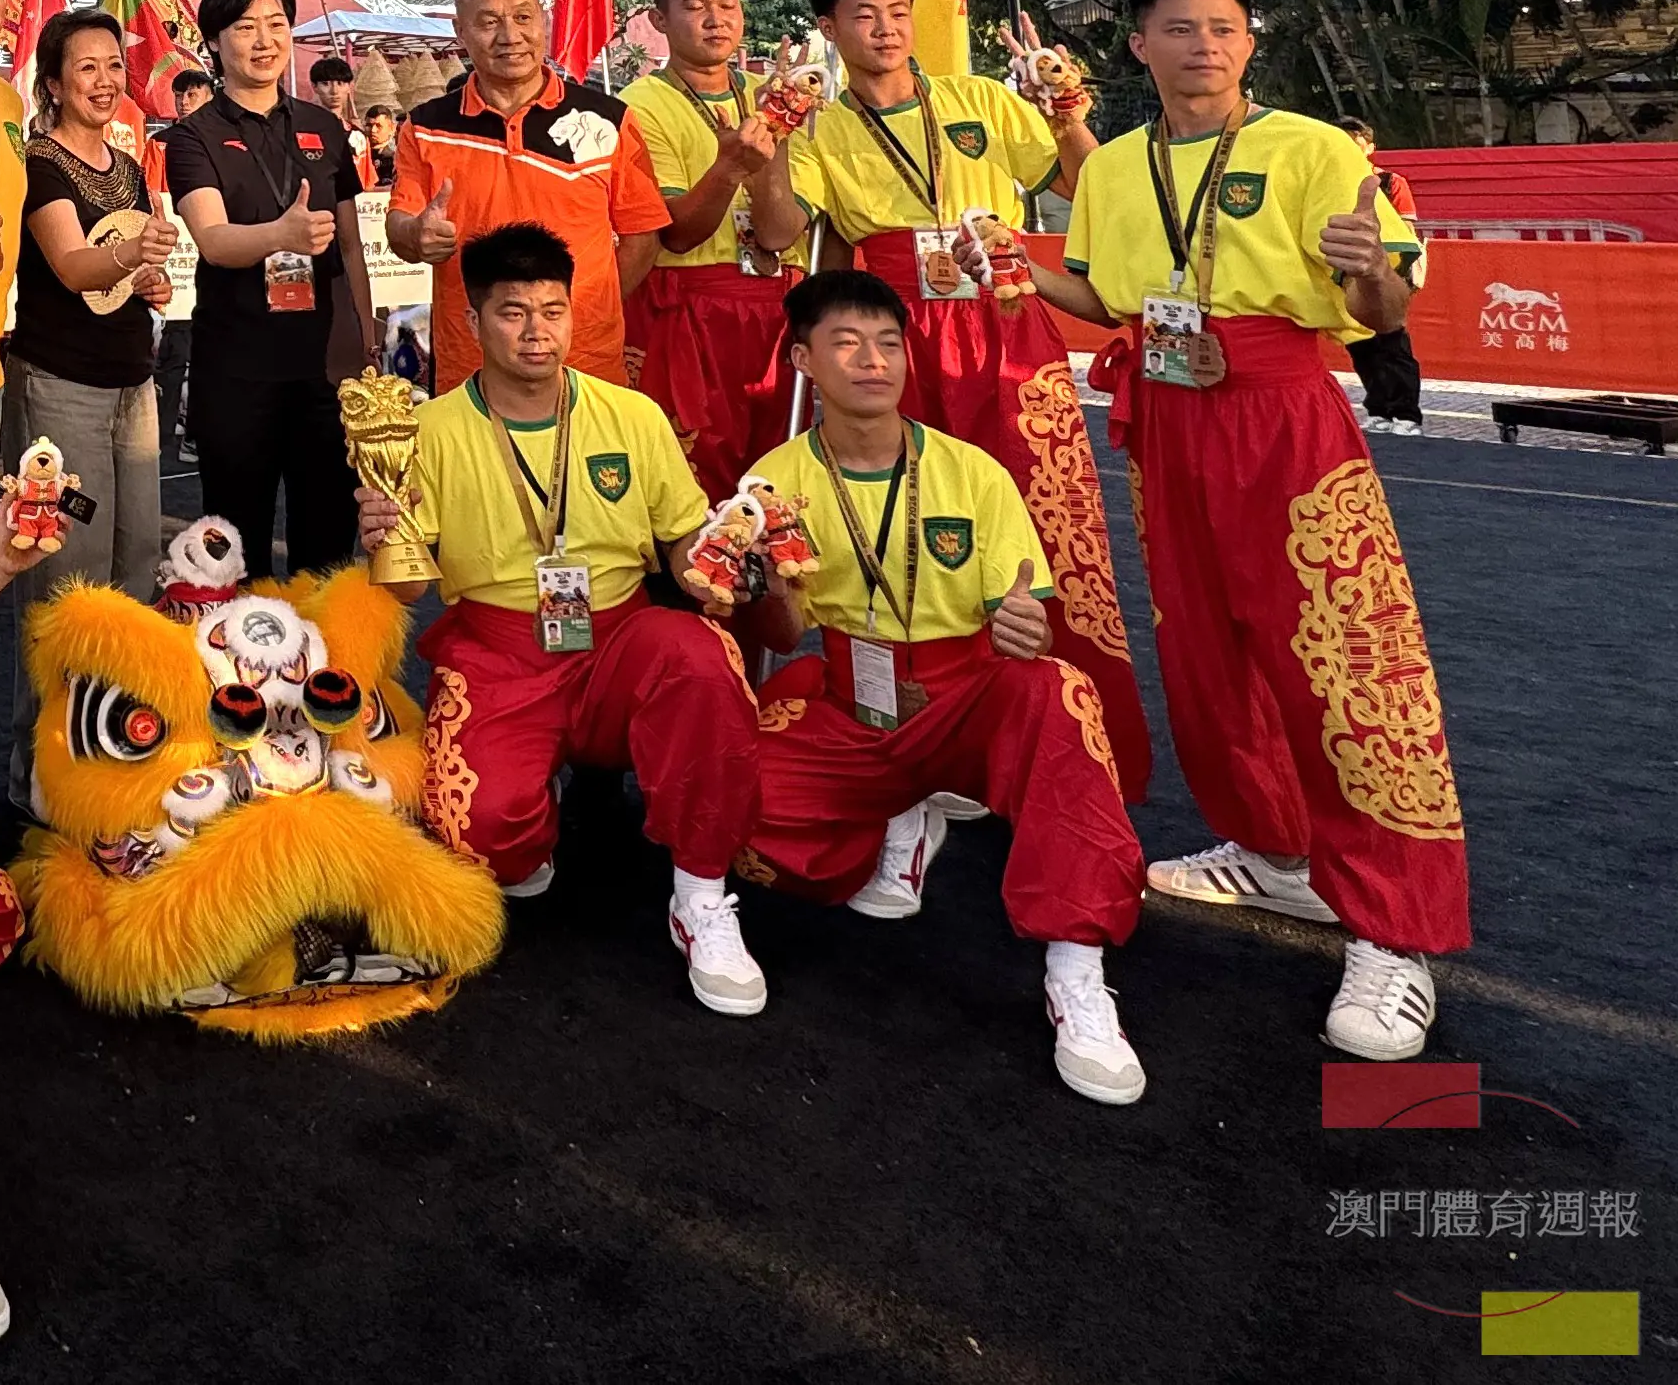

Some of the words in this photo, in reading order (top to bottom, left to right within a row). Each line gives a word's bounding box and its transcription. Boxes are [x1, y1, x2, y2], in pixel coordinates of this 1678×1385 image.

[1478, 312, 1571, 333] MGM
[1480, 332, 1570, 352] 美高梅
